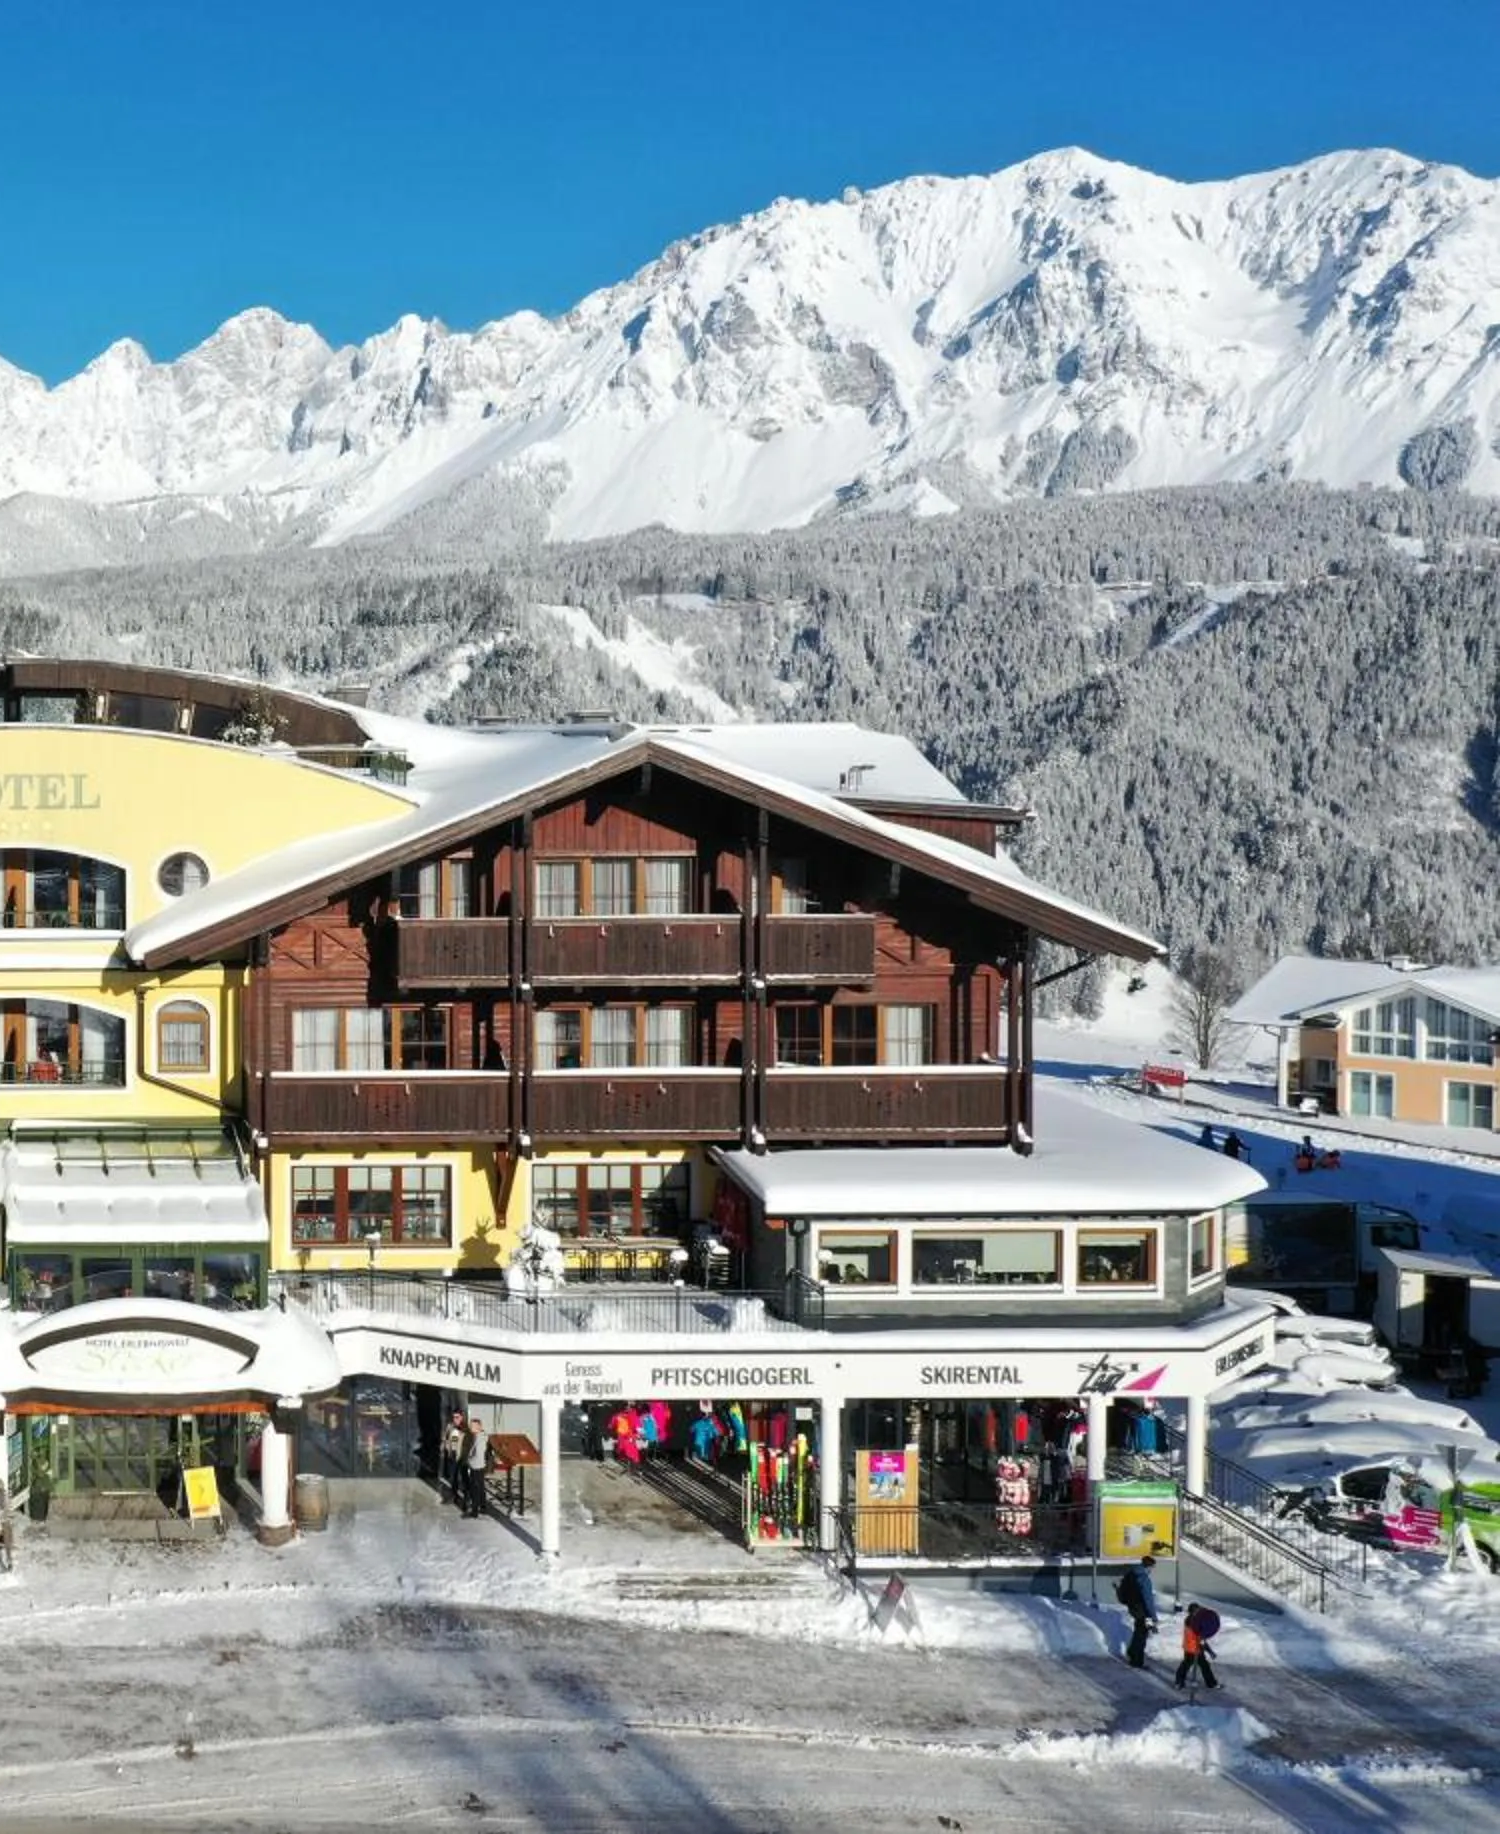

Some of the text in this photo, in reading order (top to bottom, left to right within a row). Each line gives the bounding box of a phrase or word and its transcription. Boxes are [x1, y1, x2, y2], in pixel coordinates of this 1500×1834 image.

[379, 1346, 501, 1383] KNAPPEN ALM
[651, 1367, 814, 1386] PFITSCHIGOGERL
[920, 1366, 1023, 1385] SKIRENTAL
[542, 1383, 560, 1395] aus
[563, 1380, 580, 1395] der
